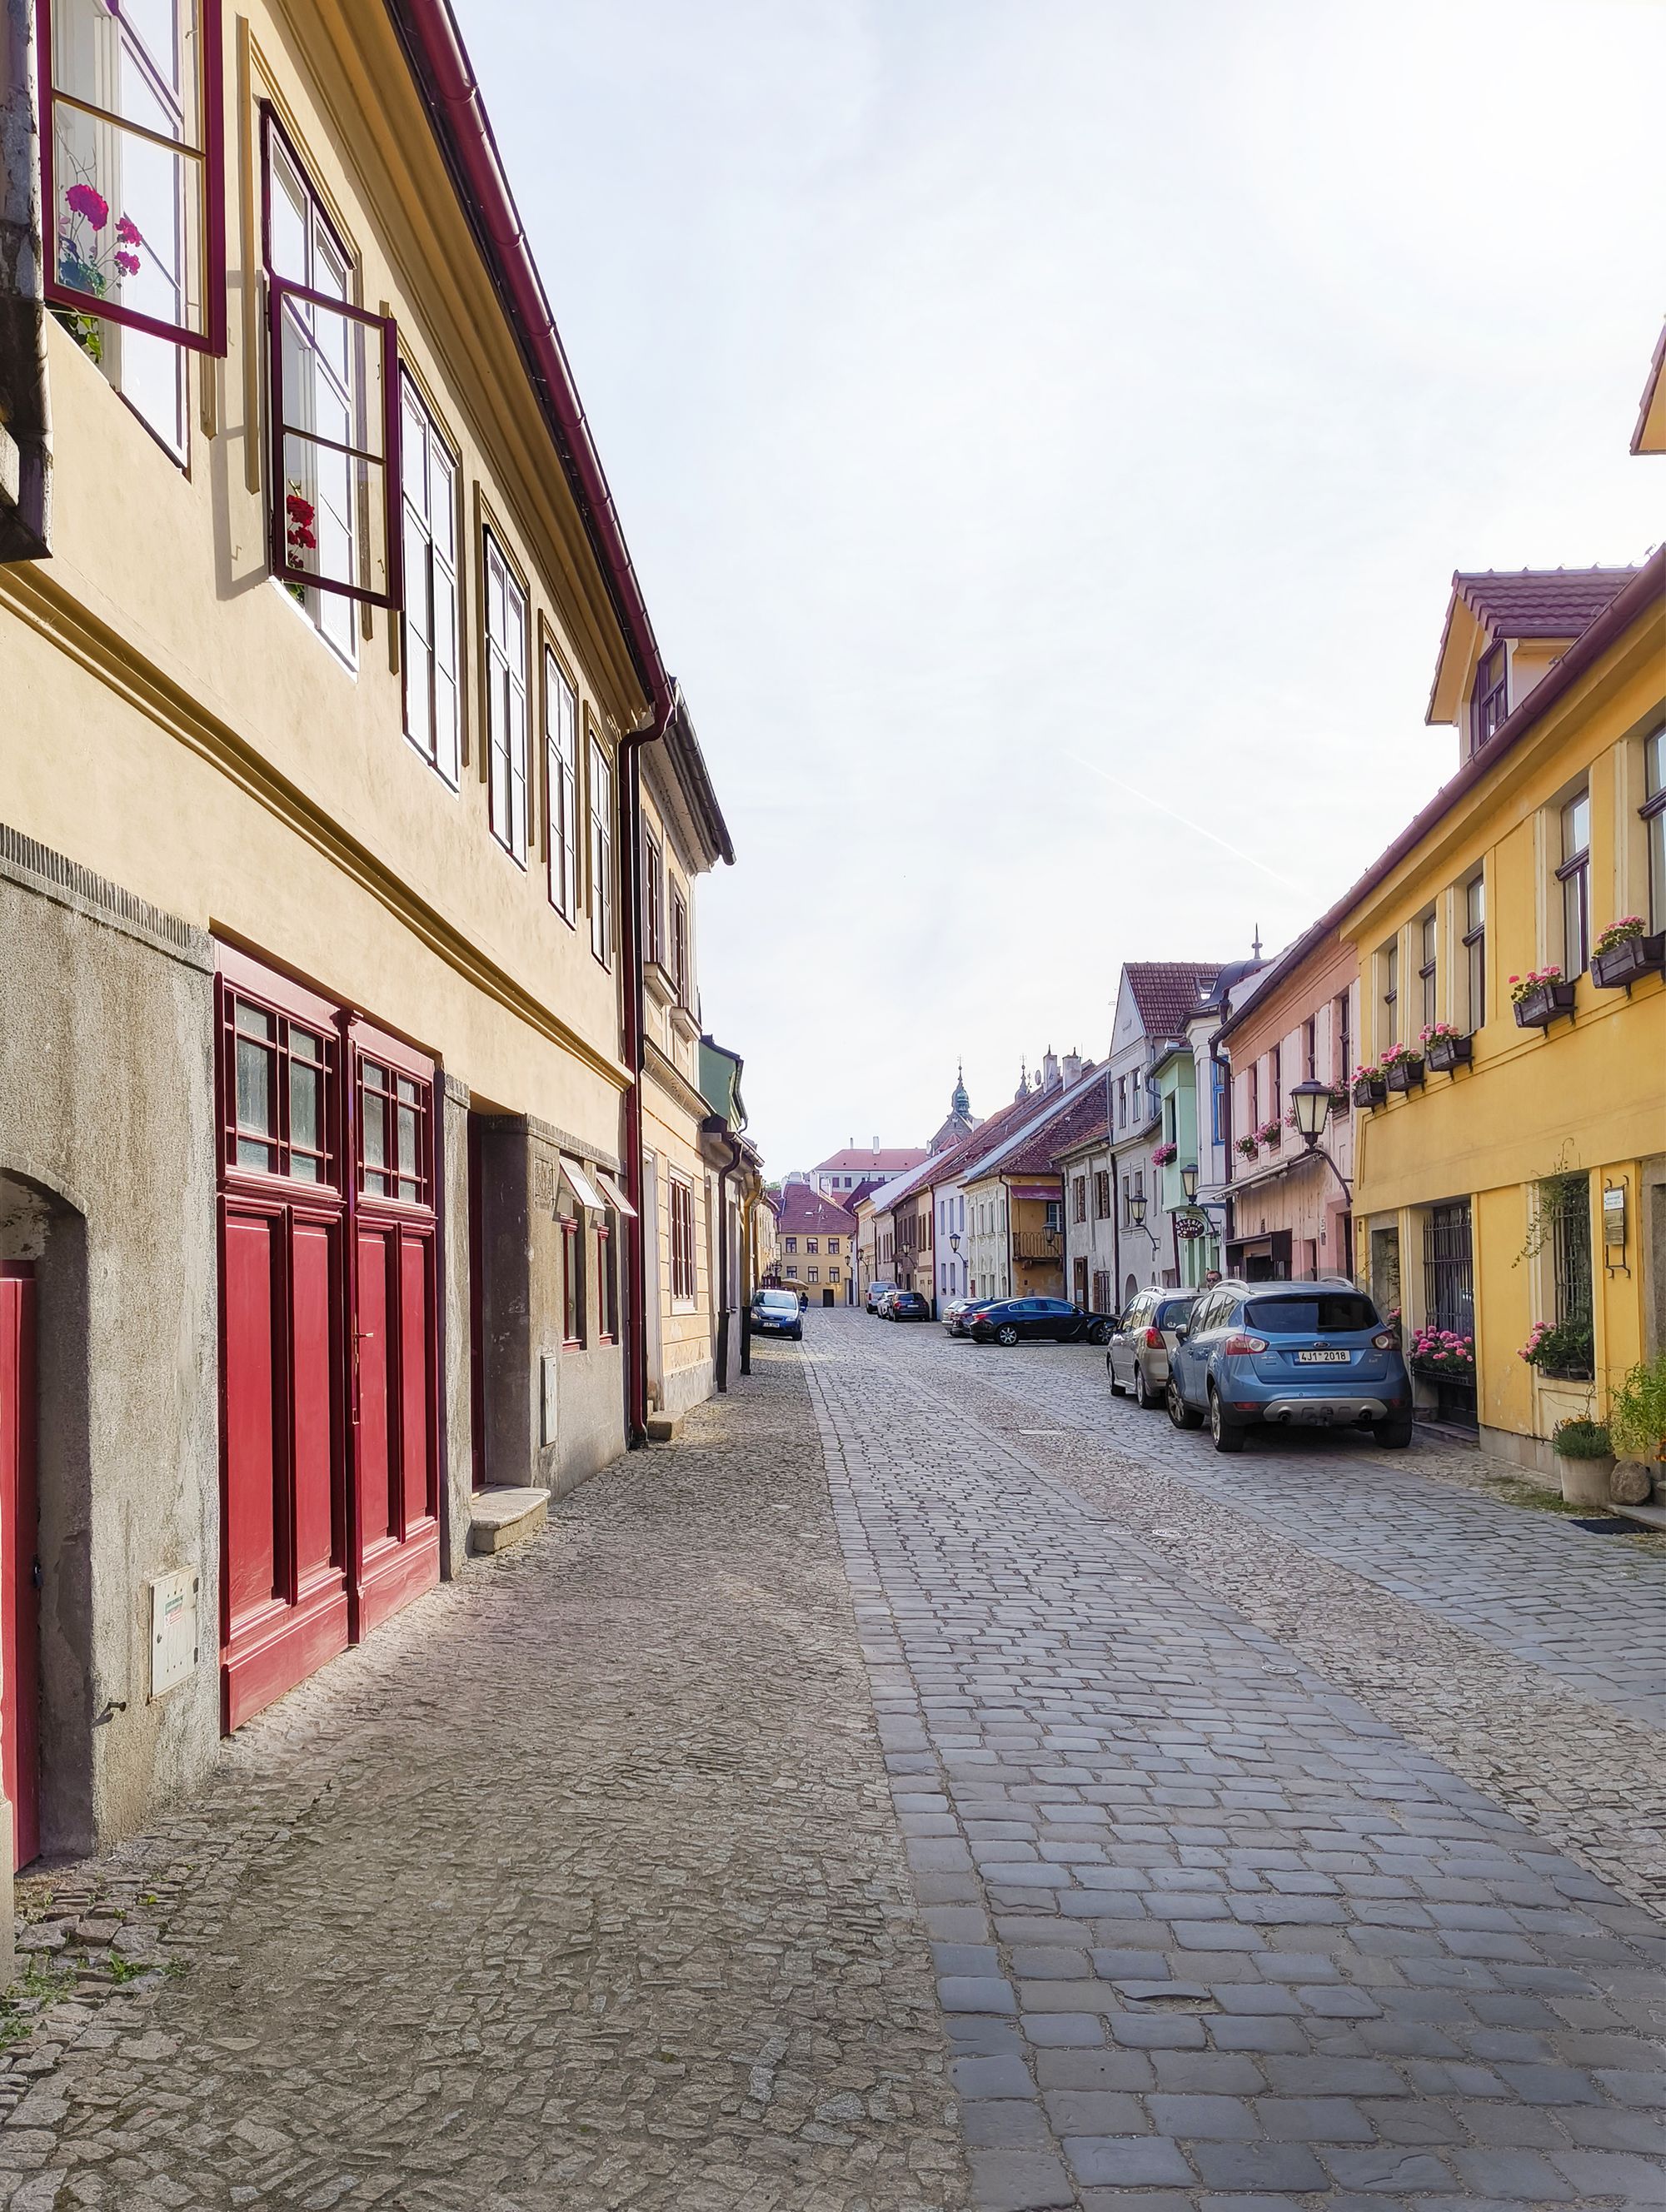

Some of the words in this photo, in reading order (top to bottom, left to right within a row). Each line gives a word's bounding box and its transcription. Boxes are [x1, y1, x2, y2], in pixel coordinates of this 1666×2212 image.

[1175, 1218, 1203, 1229] GALERIE
[1301, 1353, 1318, 1361] 4J1
[1324, 1352, 1346, 1361] 2018
